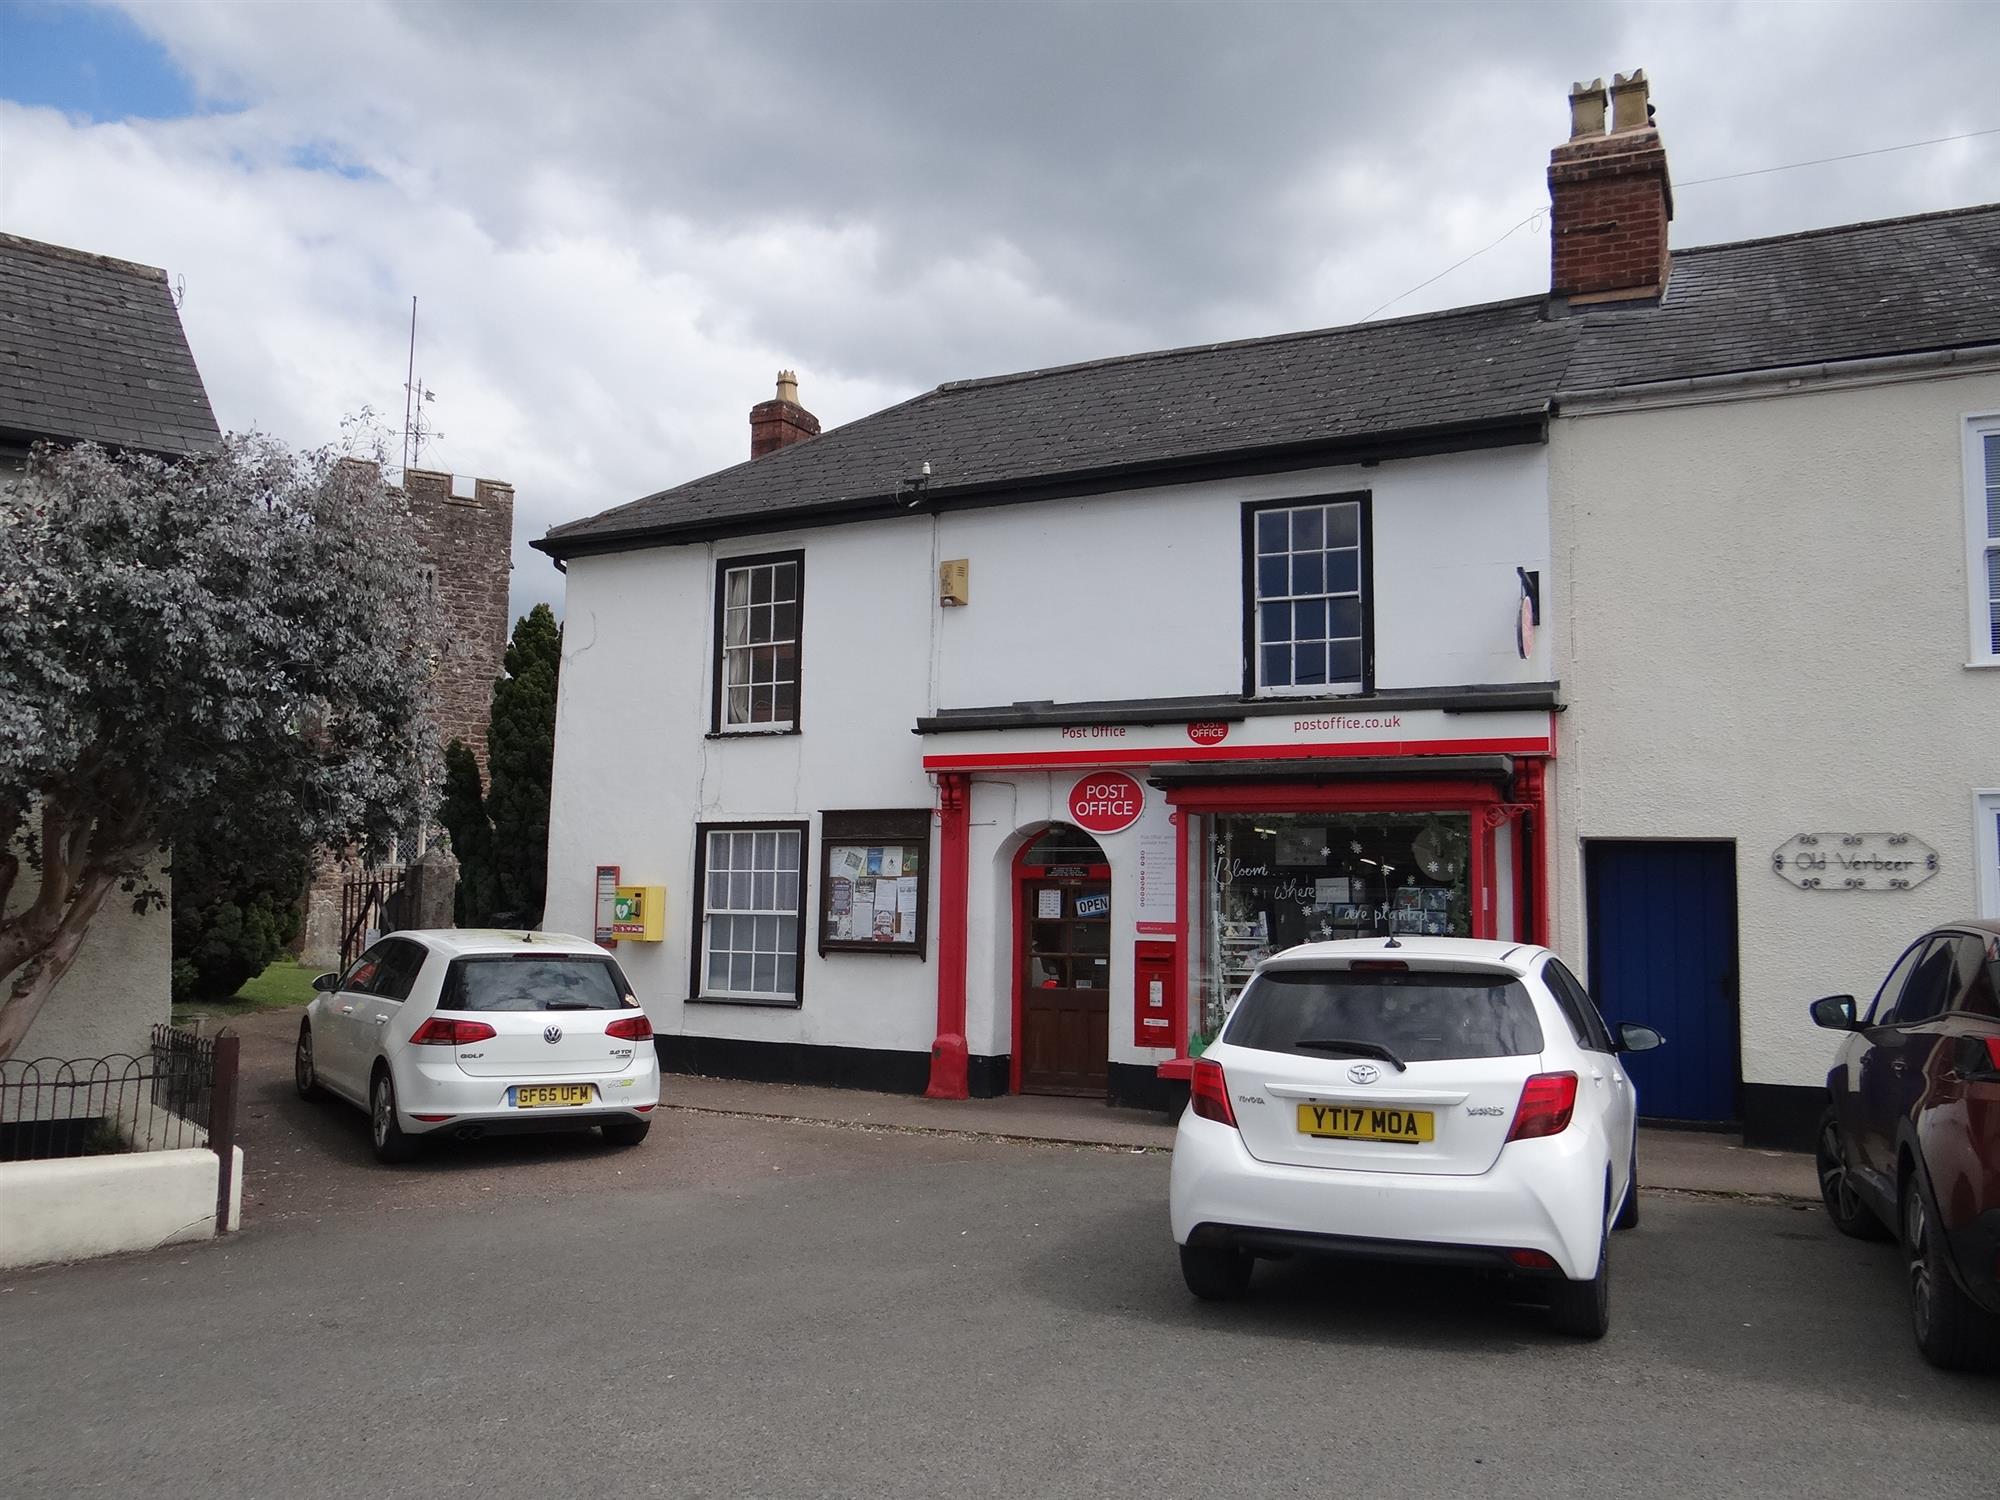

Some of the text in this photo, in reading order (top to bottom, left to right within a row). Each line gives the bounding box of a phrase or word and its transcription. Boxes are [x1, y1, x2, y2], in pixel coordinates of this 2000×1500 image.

[1294, 715, 1400, 732] postoffice.co.uk
[1062, 725, 1126, 738] Post Office
[1191, 728, 1224, 737] OFFICE
[1086, 785, 1128, 799] POST
[1076, 801, 1133, 816] OFFICE
[1796, 852, 1913, 870] Old Verbeer
[1080, 898, 1108, 913] OPEN
[519, 1086, 588, 1103] GF65 UFM
[1313, 1107, 1417, 1136] YT17 MOA
